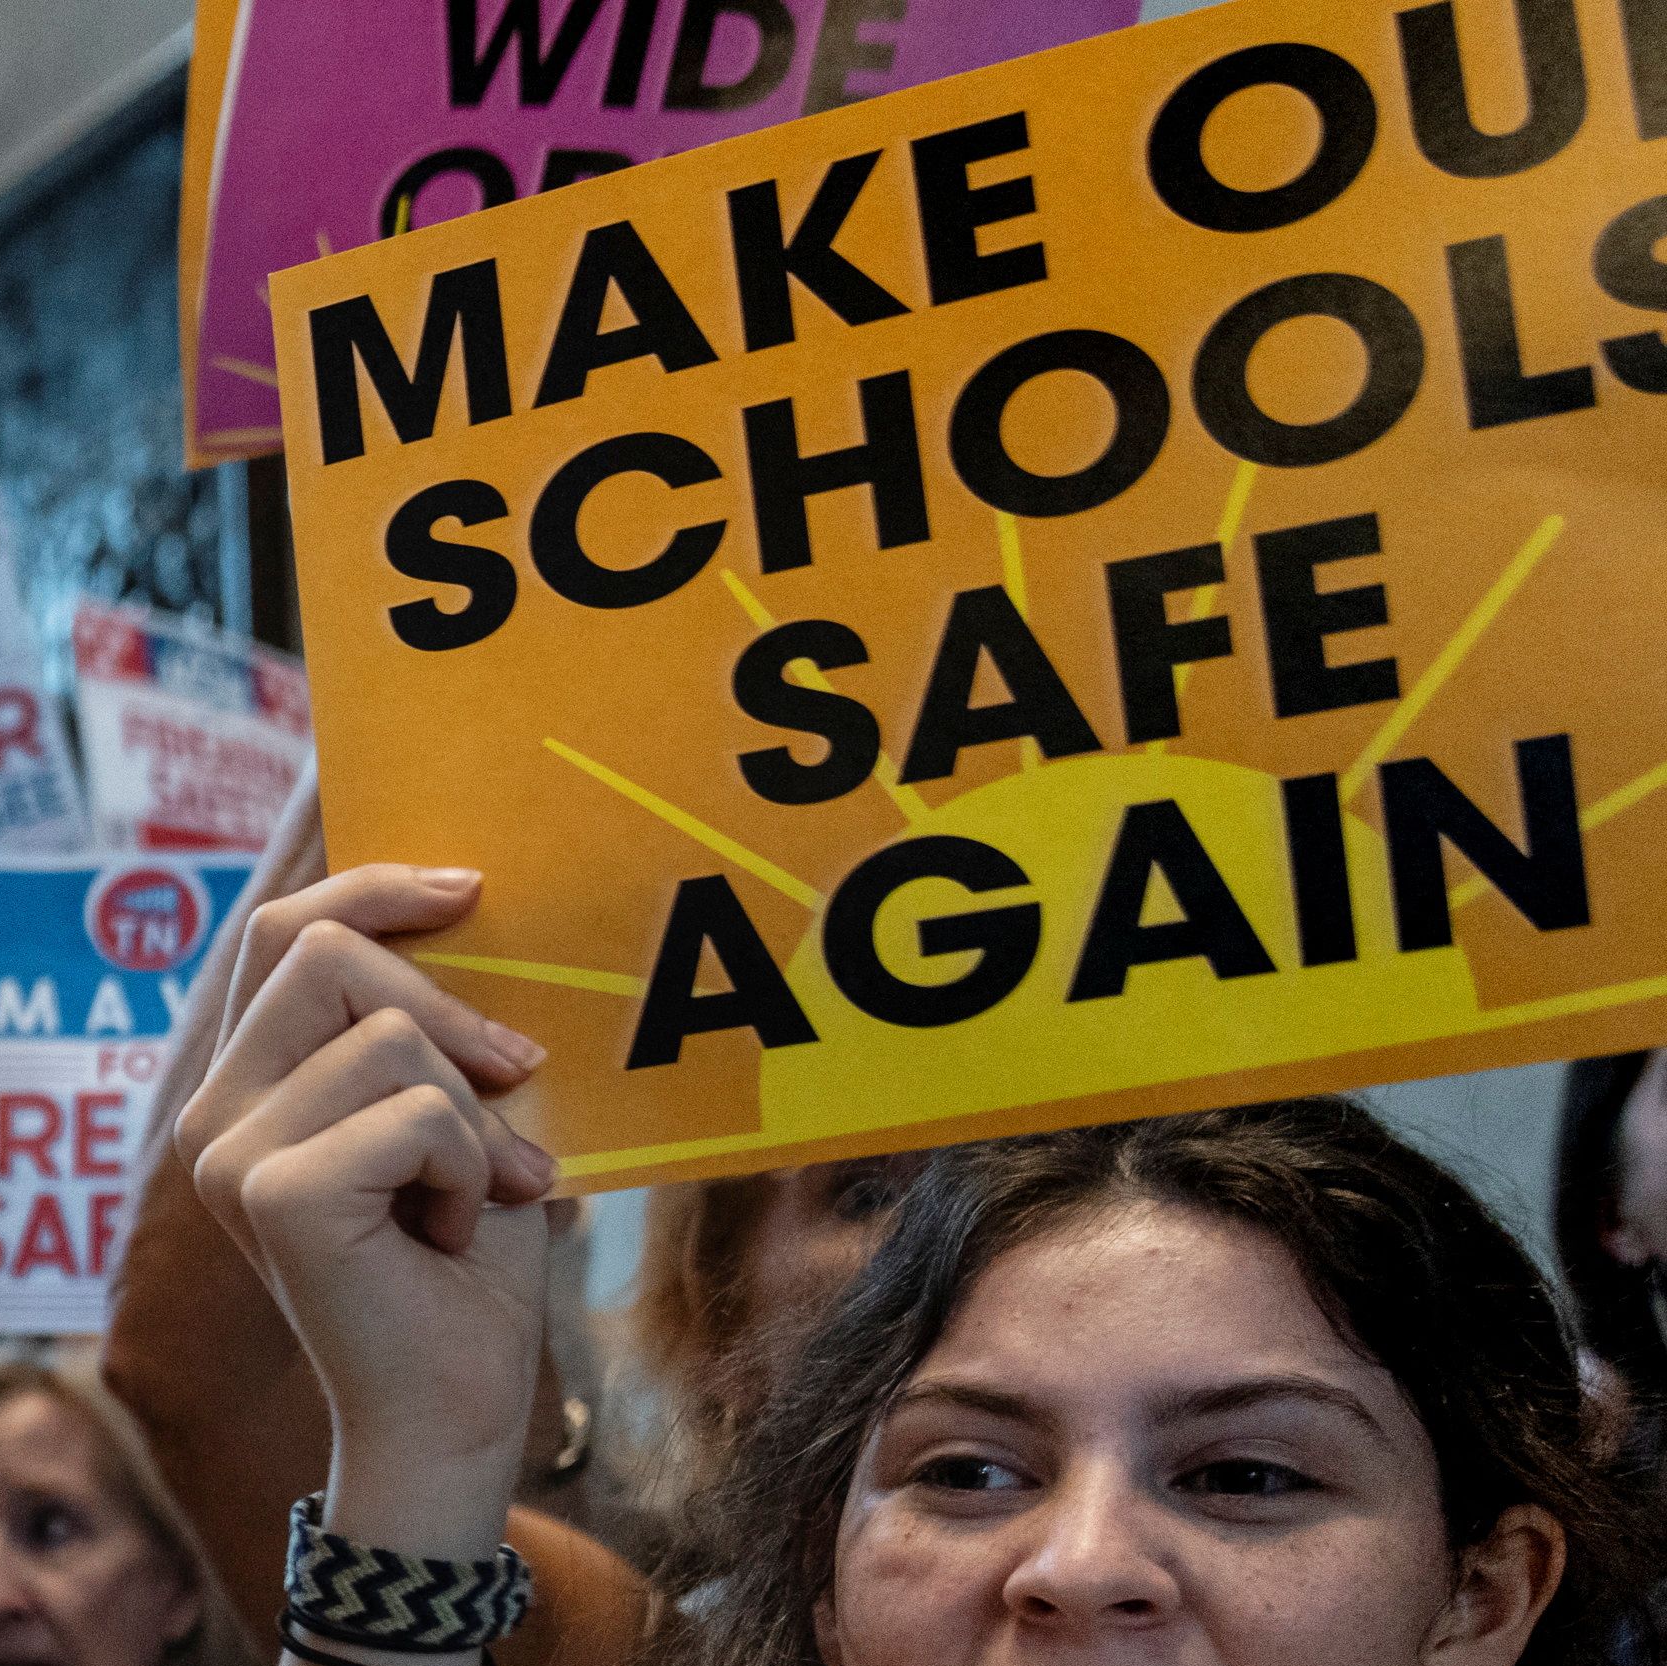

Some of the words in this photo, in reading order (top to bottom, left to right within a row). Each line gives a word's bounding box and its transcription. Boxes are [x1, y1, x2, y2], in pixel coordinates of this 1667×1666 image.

[445, 0, 911, 116] WIDE
[309, 112, 1048, 466] MAKE
[731, 512, 1401, 806] SAFE
[113, 917, 180, 960] TN
[625, 732, 1592, 1072] AGAIN
[86, 976, 136, 1034] A
